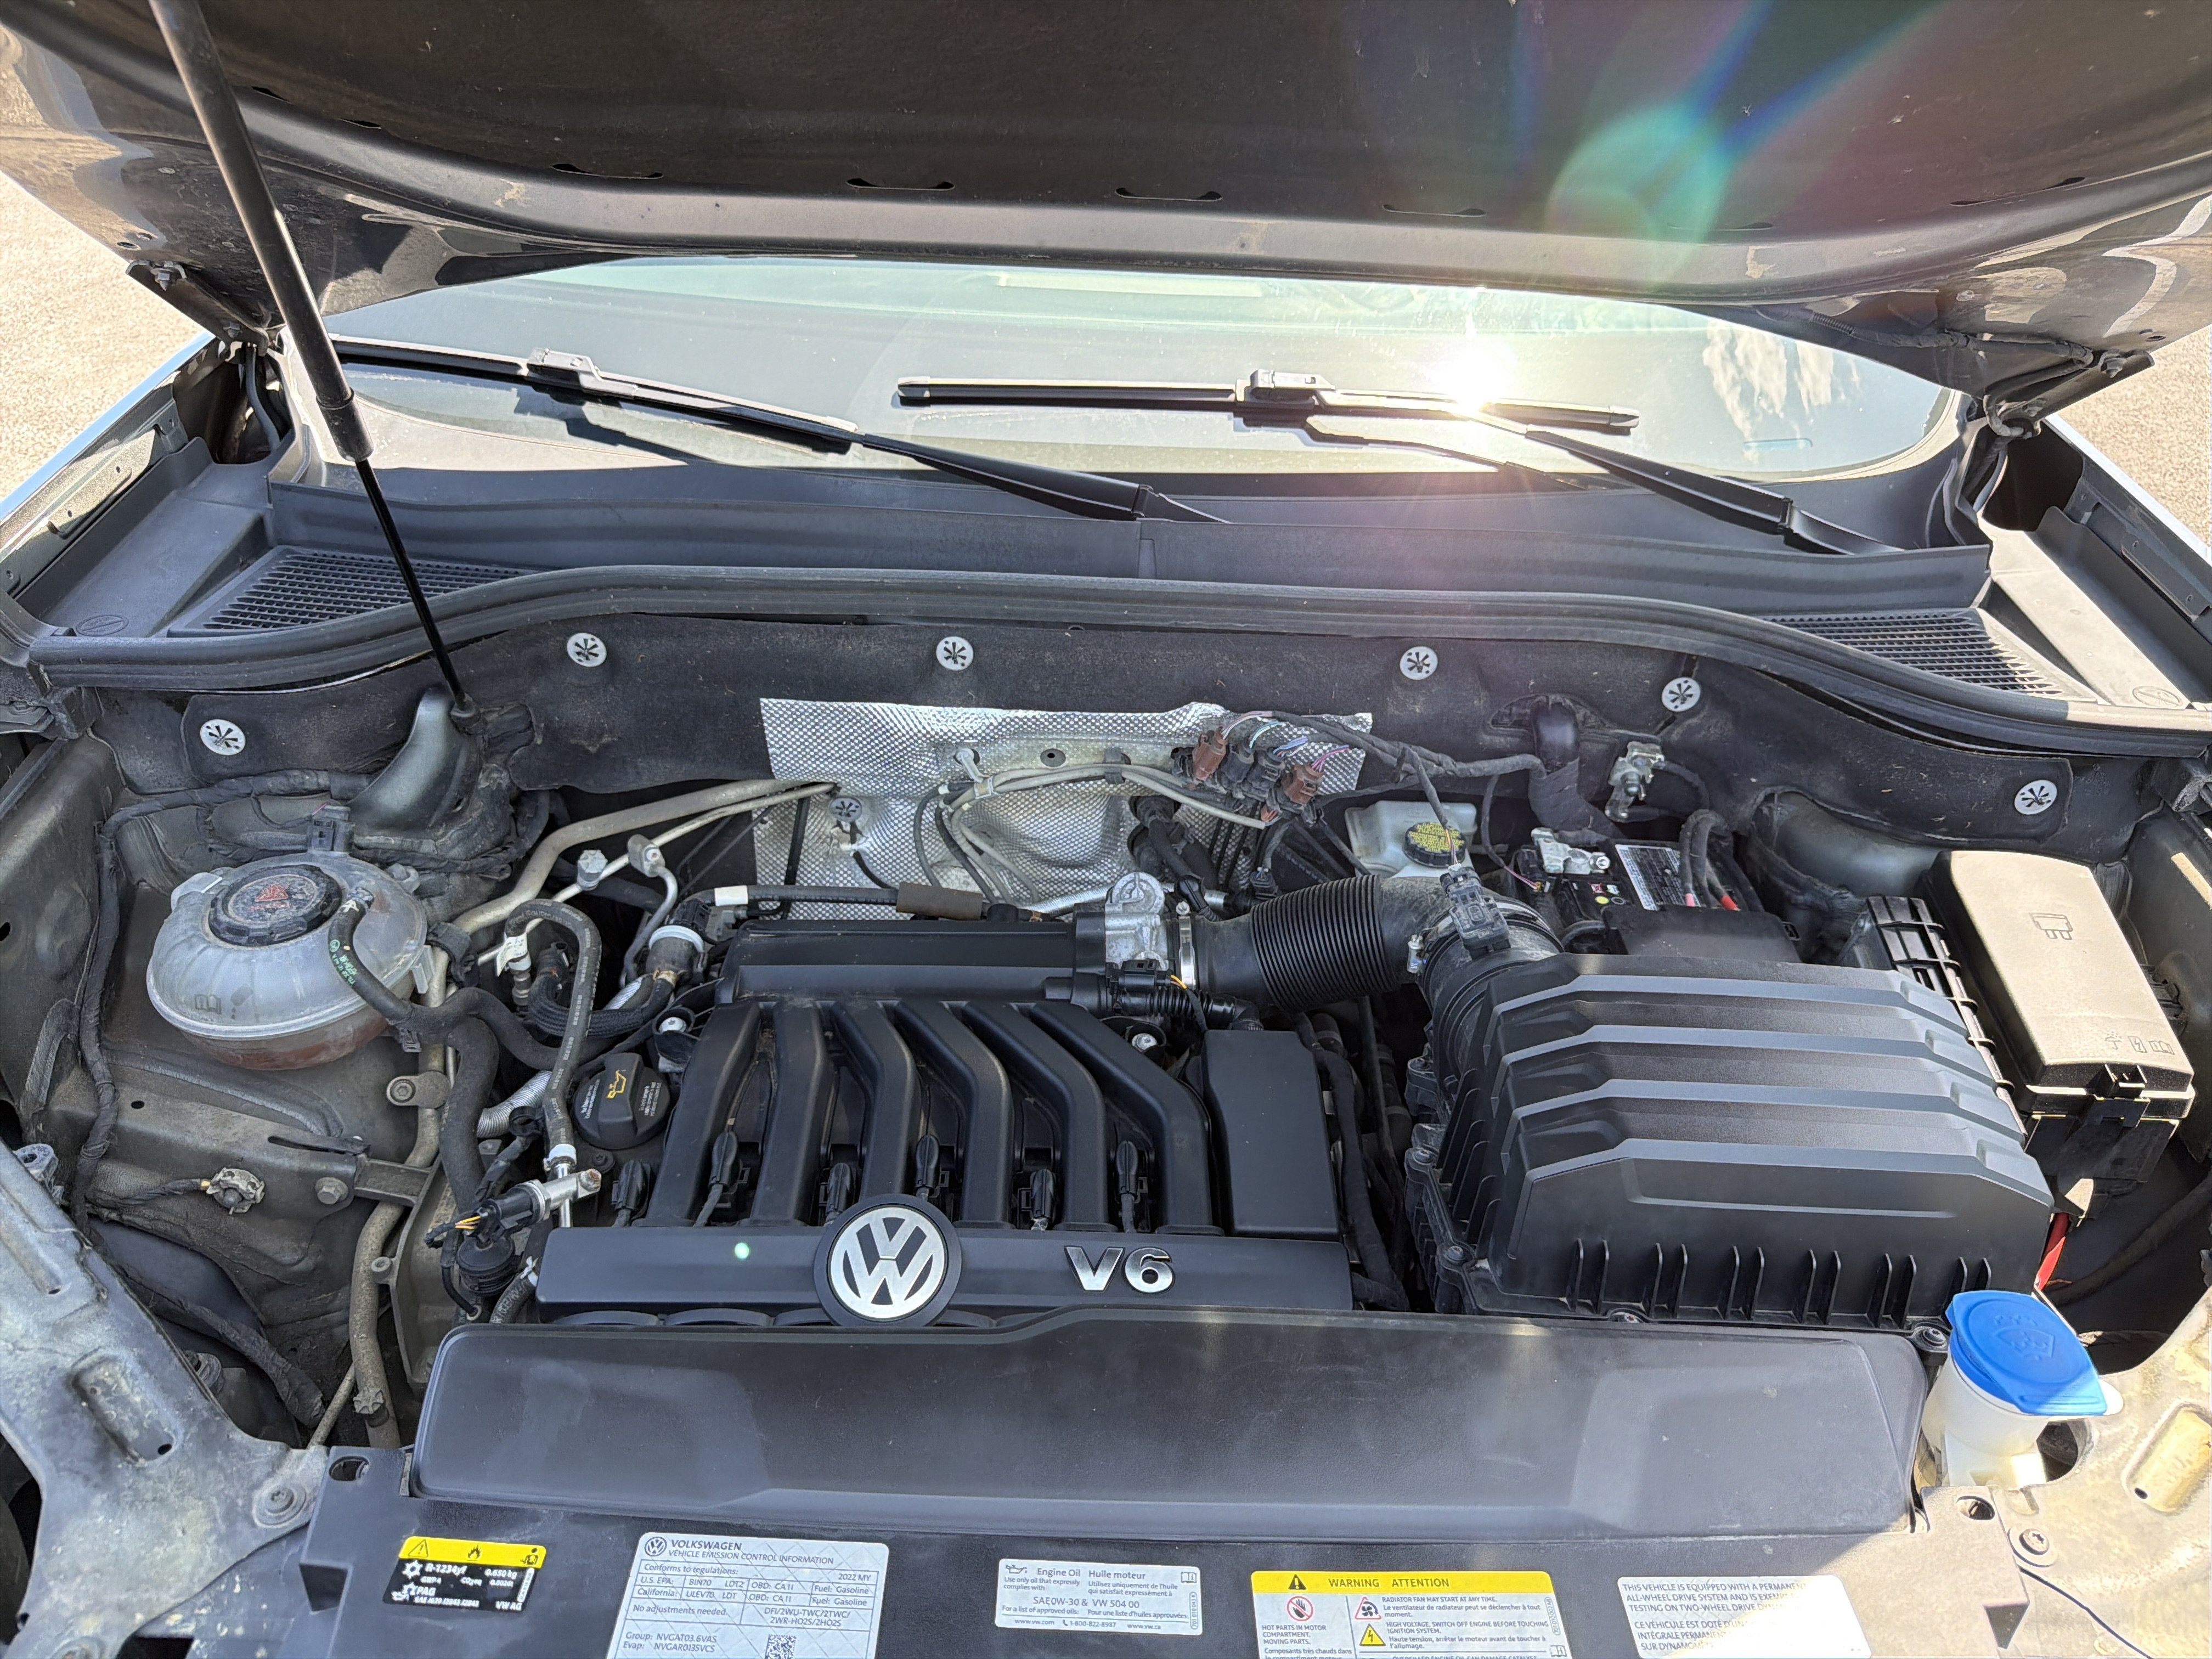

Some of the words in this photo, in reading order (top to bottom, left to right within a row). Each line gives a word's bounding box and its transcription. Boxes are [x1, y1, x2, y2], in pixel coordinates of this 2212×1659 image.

[831, 1206, 945, 1318] VW
[1064, 1245, 1176, 1294] V6
[672, 1539, 742, 1551] VOLKSWAGEN
[669, 1549, 699, 1558] VEHICLE
[702, 1551, 739, 1559] EMISSION
[741, 1553, 777, 1562] CONTROL
[780, 1555, 834, 1564] INFORMATION
[484, 1568, 507, 1577] 0.650
[507, 1570, 517, 1579] kg
[645, 1564, 681, 1572] Conforms
[693, 1566, 738, 1575] regulations:
[1037, 1568, 1066, 1577] Engine
[1088, 1570, 1111, 1578] Huile
[1114, 1571, 1146, 1579] moteur
[1328, 1578, 1380, 1588] WARNING
[1392, 1578, 1449, 1587] ATTENTION
[1686, 1583, 1726, 1592] EQUIPPED
[416, 1587, 436, 1596] PAG
[637, 1588, 678, 1596] California:
[836, 1586, 869, 1594] Gasoline
[749, 1593, 769, 1601] OBD:
[495, 1601, 510, 1610] VW
[510, 1602, 522, 1611] AG
[834, 1598, 867, 1606] Gasoline
[646, 1606, 695, 1614] adjustments
[1646, 1620, 1686, 1629] VÉHICULE
[1701, 1620, 1722, 1628] DOTÉ
[626, 1632, 653, 1641] Group:
[657, 1633, 717, 1643] NVGAT03.6VAS
[1638, 1630, 1680, 1639] INTÉGRALE
[623, 1641, 645, 1650] Evap:
